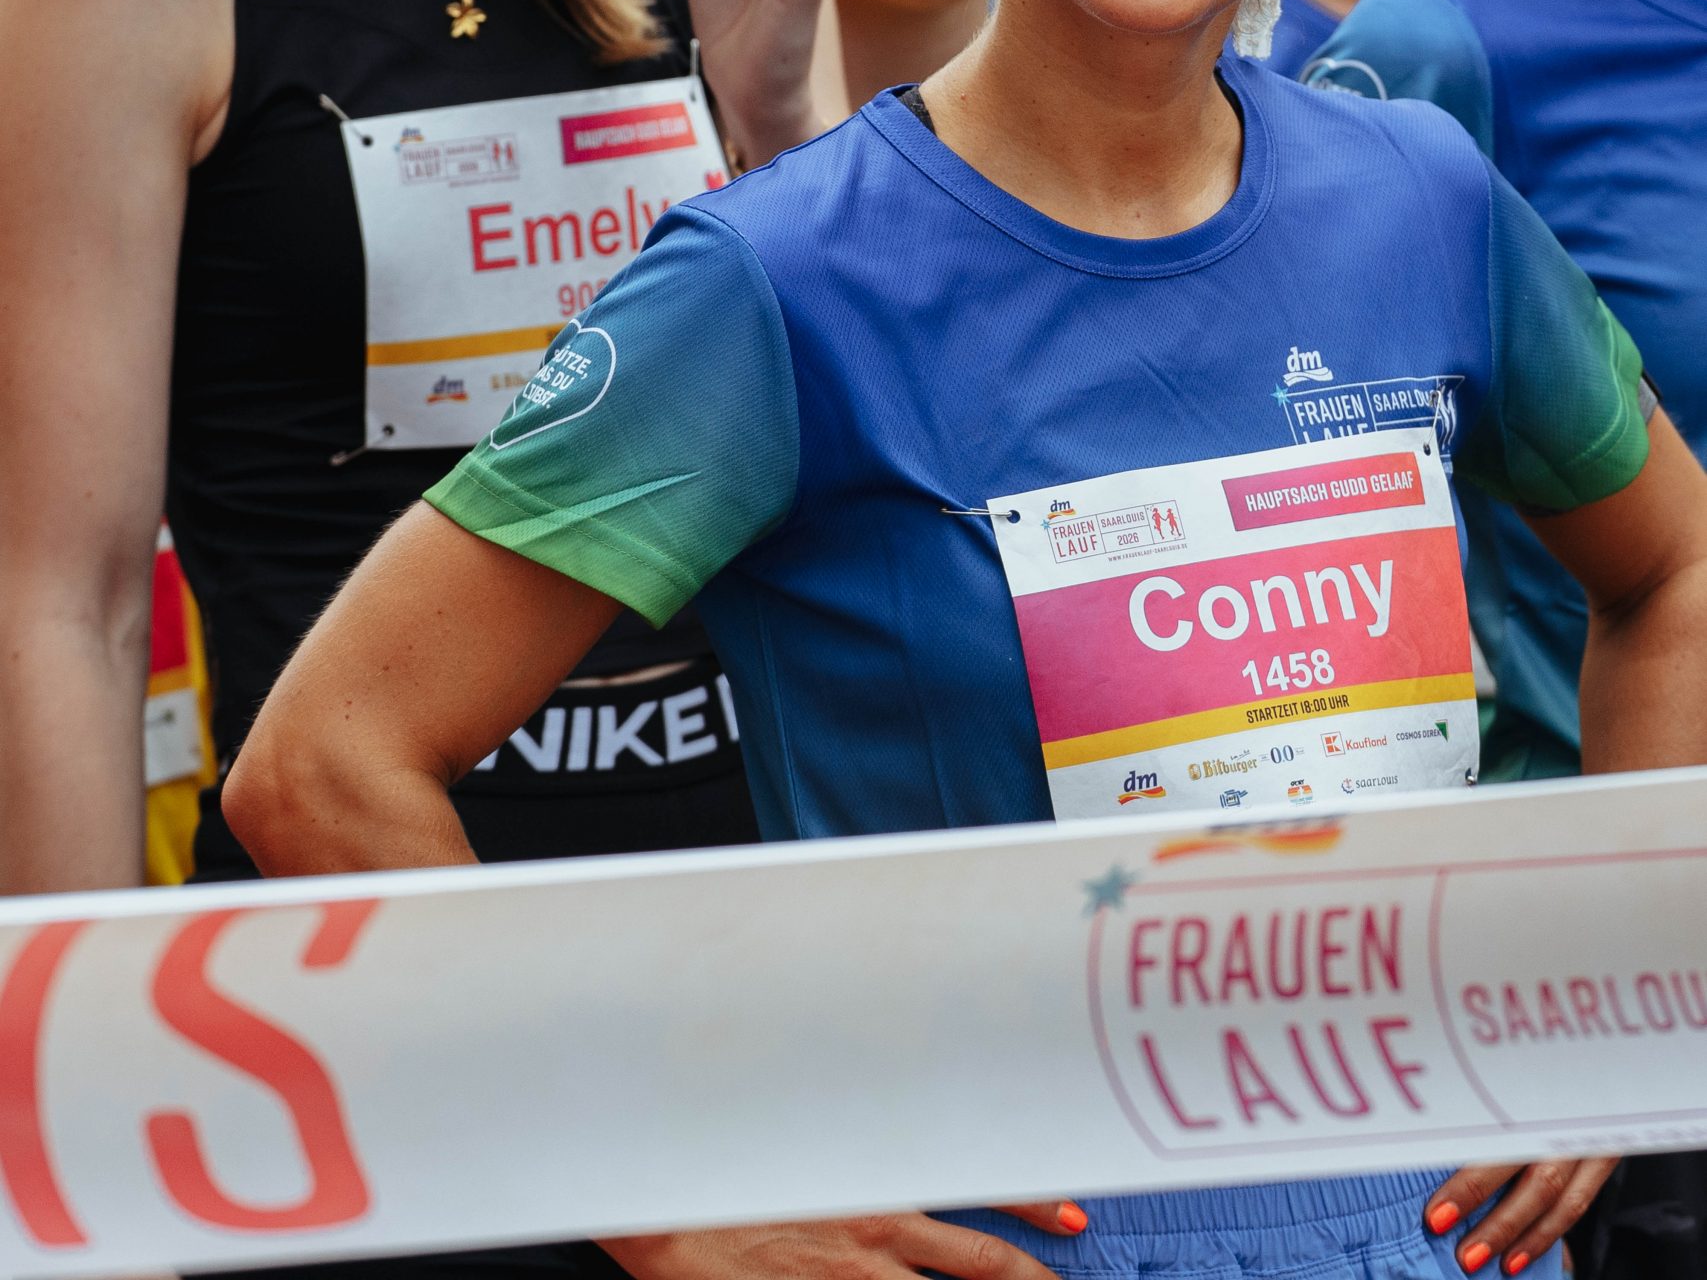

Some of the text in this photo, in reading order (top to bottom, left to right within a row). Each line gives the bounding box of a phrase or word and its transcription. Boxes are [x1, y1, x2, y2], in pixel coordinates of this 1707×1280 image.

[558, 279, 608, 317] 90
[1287, 346, 1322, 373] dm
[433, 376, 464, 394] dm
[551, 371, 575, 391] DU
[1294, 393, 1366, 427] FRAUEN
[1373, 387, 1438, 413] SAARLOU
[1245, 470, 1414, 512] HAUPTSACH GUDD GELAAF
[1050, 499, 1071, 513] dm
[1053, 520, 1095, 540] FRAUEN
[1100, 512, 1145, 528] SAARLOUIS
[1056, 534, 1098, 558] LAUF
[1117, 532, 1139, 546] 2026
[1128, 559, 1394, 653] Conny
[1242, 648, 1336, 696] 1458
[1246, 694, 1350, 724] STARTZEIT 18:00 UHR
[1345, 735, 1388, 751] Kaufland
[1396, 730, 1422, 741] COSMOS
[1203, 758, 1258, 779] Bitburger
[1123, 770, 1157, 793] dm
[1127, 904, 1405, 1008] FRAUEN
[1139, 1016, 1428, 1130] LAUF
